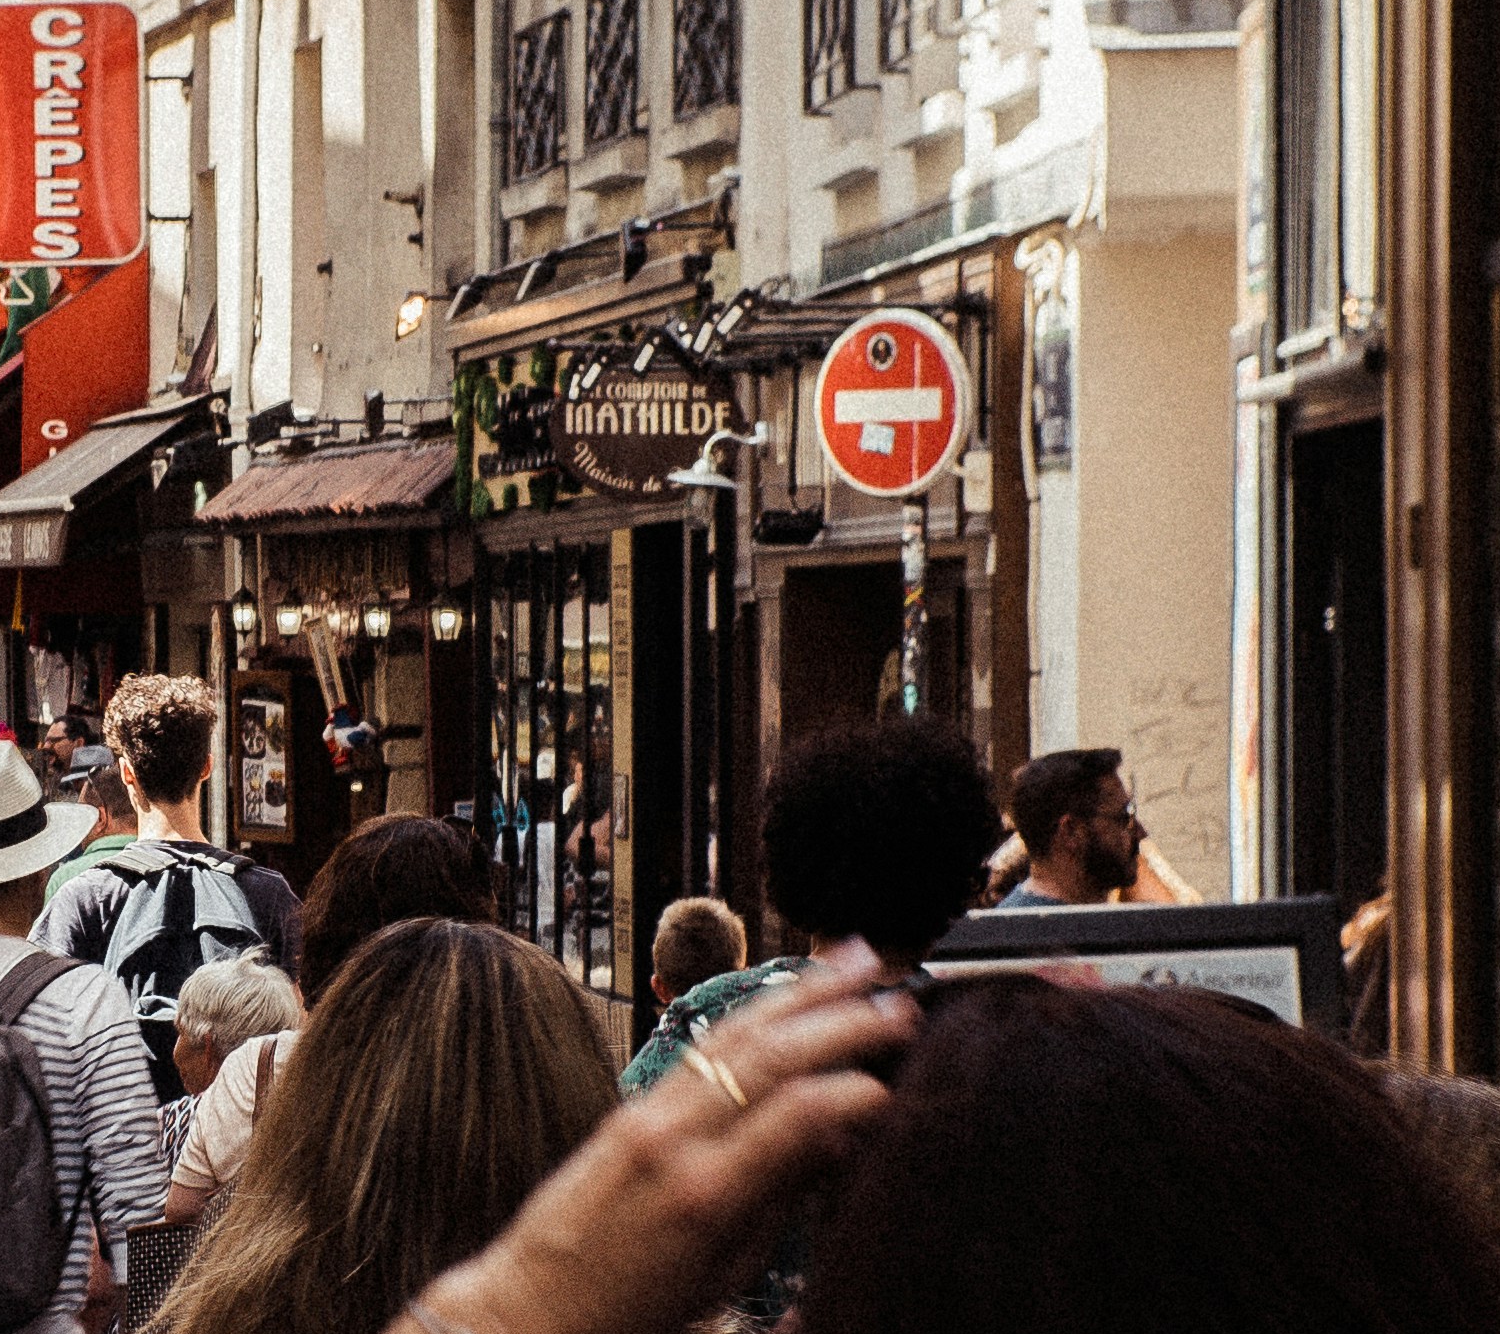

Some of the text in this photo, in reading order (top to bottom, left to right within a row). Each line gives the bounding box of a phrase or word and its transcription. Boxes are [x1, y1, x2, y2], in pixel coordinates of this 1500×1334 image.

[29, 7, 86, 261] CRÊPES
[606, 381, 688, 400] COMPTOIR
[573, 440, 663, 493] Maison de
